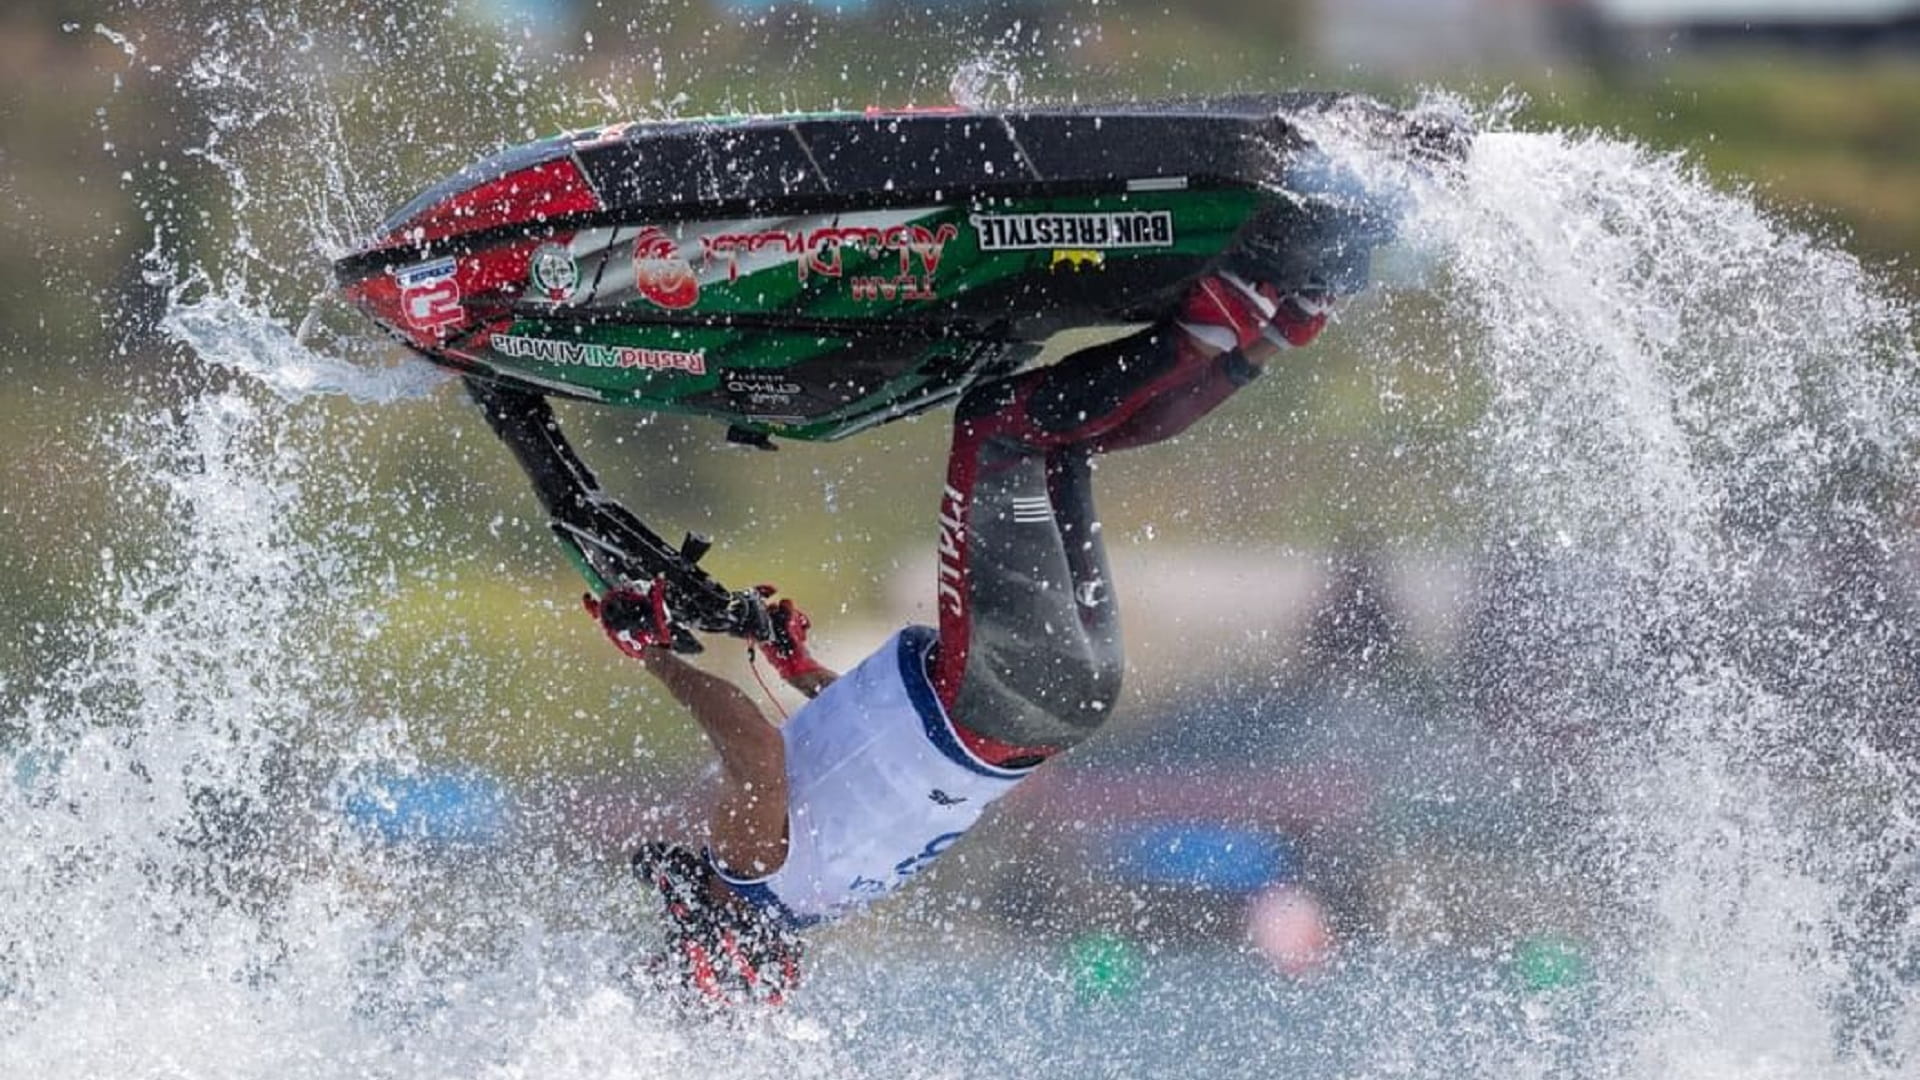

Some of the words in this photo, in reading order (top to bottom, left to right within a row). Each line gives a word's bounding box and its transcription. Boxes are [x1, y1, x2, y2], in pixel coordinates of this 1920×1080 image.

[842, 223, 958, 275] Abu
[980, 215, 1109, 246] FREESTYLE
[700, 229, 843, 285] Dhabi
[851, 276, 936, 300] TEAM
